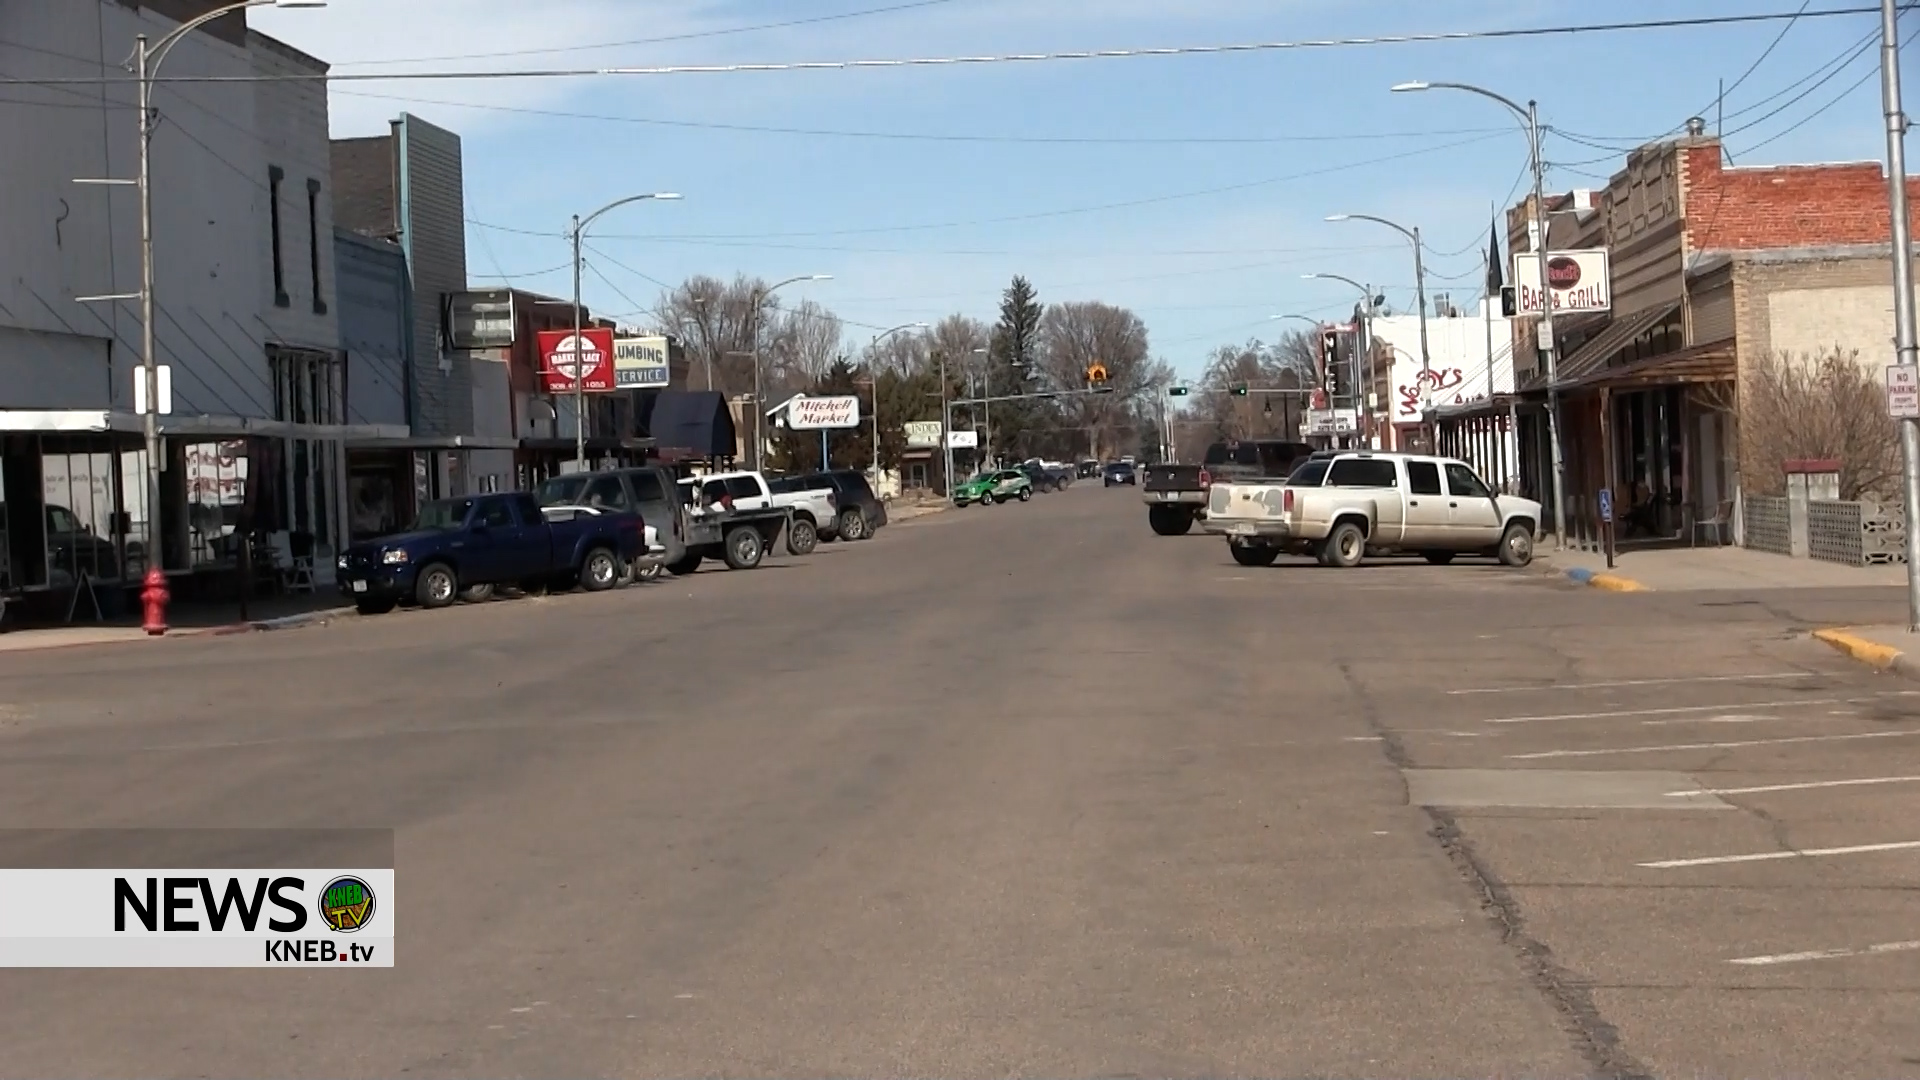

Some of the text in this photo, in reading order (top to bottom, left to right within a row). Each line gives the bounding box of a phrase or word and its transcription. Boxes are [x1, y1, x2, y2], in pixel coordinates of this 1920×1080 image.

[1568, 282, 1604, 308] GRILL
[1896, 373, 1909, 382] NO
[795, 400, 852, 411] Mitchell
[799, 413, 850, 423] Market
